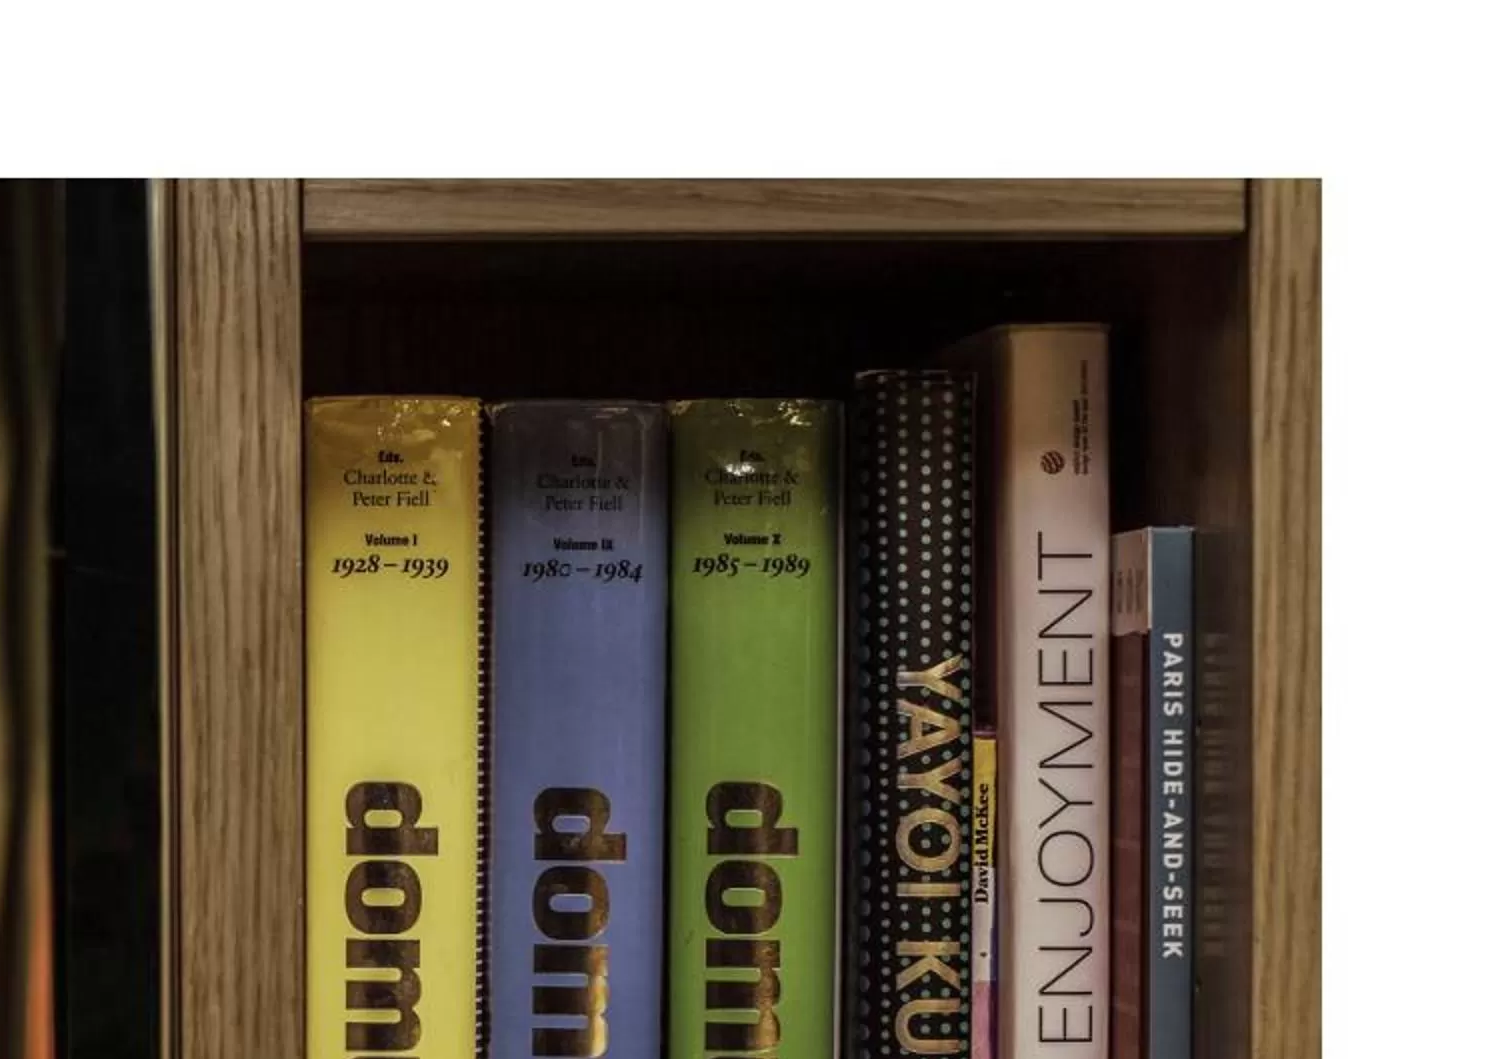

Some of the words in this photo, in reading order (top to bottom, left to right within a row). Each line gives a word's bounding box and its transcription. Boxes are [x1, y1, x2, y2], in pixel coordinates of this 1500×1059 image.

[343, 470, 418, 486] Charlotte
[782, 469, 800, 486] &
[352, 491, 391, 507] Peter
[396, 491, 429, 507] Fiell
[545, 496, 584, 512] Peter
[589, 496, 623, 512] Fiell
[714, 491, 753, 507] Peter
[757, 491, 791, 507] Fiell
[365, 535, 410, 547] Volume
[553, 538, 598, 551] Volume
[601, 538, 614, 551] IX
[724, 534, 770, 547] Volume
[774, 534, 781, 547] X
[1162, 632, 1184, 717] PARIS
[895, 653, 963, 897] YAYOI
[1038, 531, 1094, 1043] ENJOYMENT
[975, 783, 989, 850] McKee
[1162, 729, 1184, 958] HIDE-AND-SEEK
[975, 851, 989, 904] David
